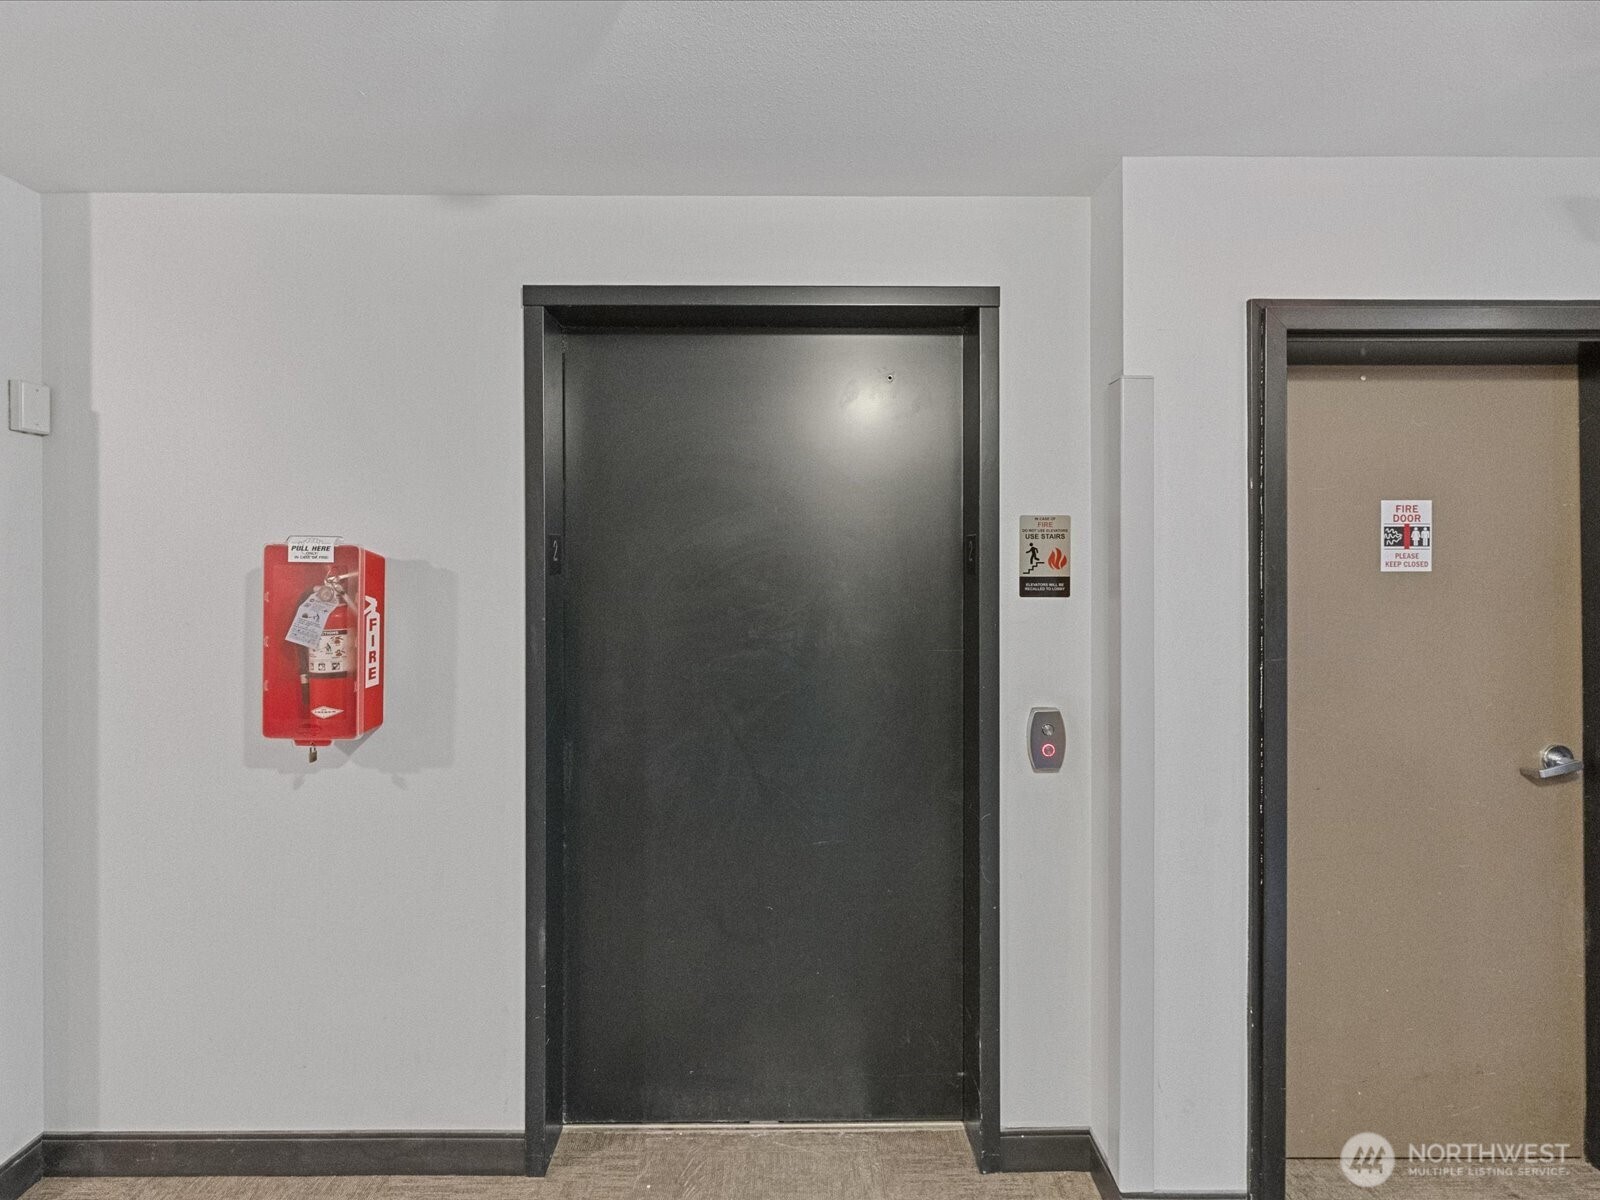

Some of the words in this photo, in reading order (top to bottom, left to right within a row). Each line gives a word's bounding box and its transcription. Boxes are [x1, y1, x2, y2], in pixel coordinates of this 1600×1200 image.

[1395, 504, 1419, 513] FIRE
[1393, 514, 1421, 523] DOOR
[552, 540, 559, 562] 2
[1394, 552, 1420, 560] PLEASE
[1384, 560, 1402, 568] KEEP
[1403, 560, 1429, 568] CLOSED
[368, 618, 377, 681] FIRE
